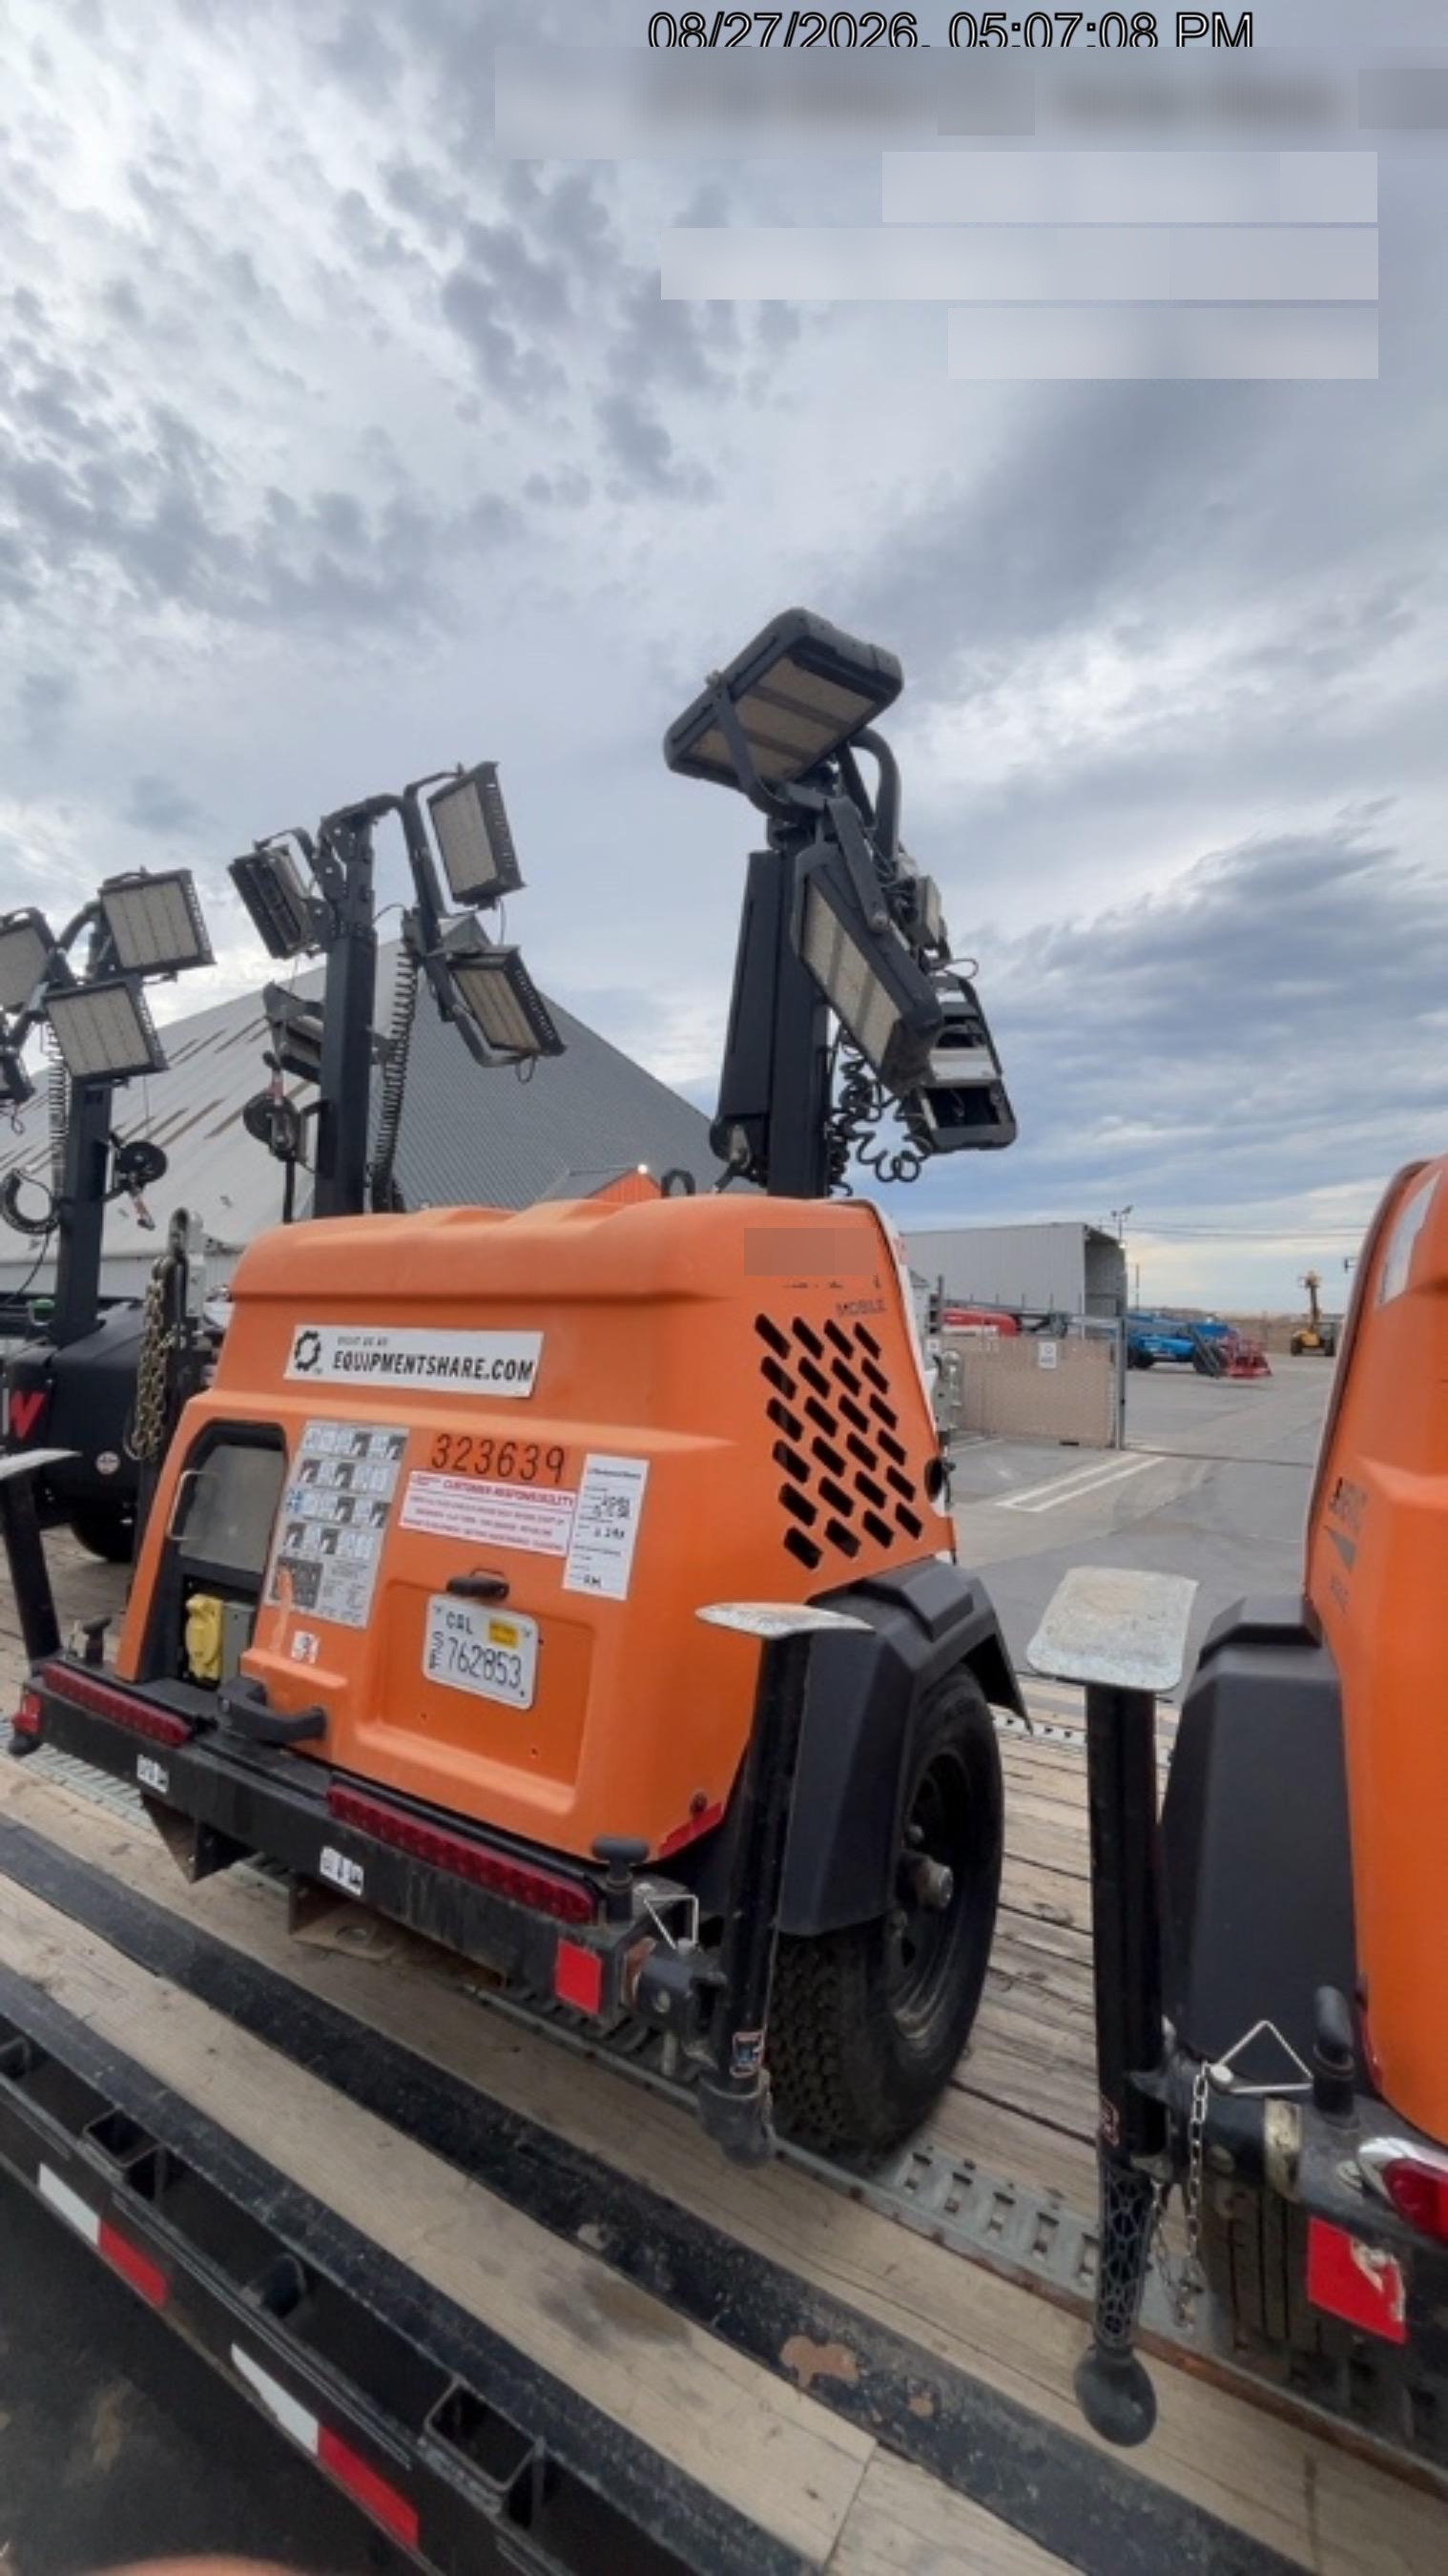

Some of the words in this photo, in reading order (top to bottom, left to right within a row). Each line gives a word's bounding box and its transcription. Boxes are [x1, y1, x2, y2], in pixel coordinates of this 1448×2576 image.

[333, 1350, 533, 1381] EQUIPMENTSHARE.COM
[431, 1433, 565, 1485] 323639
[443, 1479, 492, 1499] CUSTOMER
[445, 1610, 473, 1634] CAL
[447, 1636, 522, 1690] 762853
